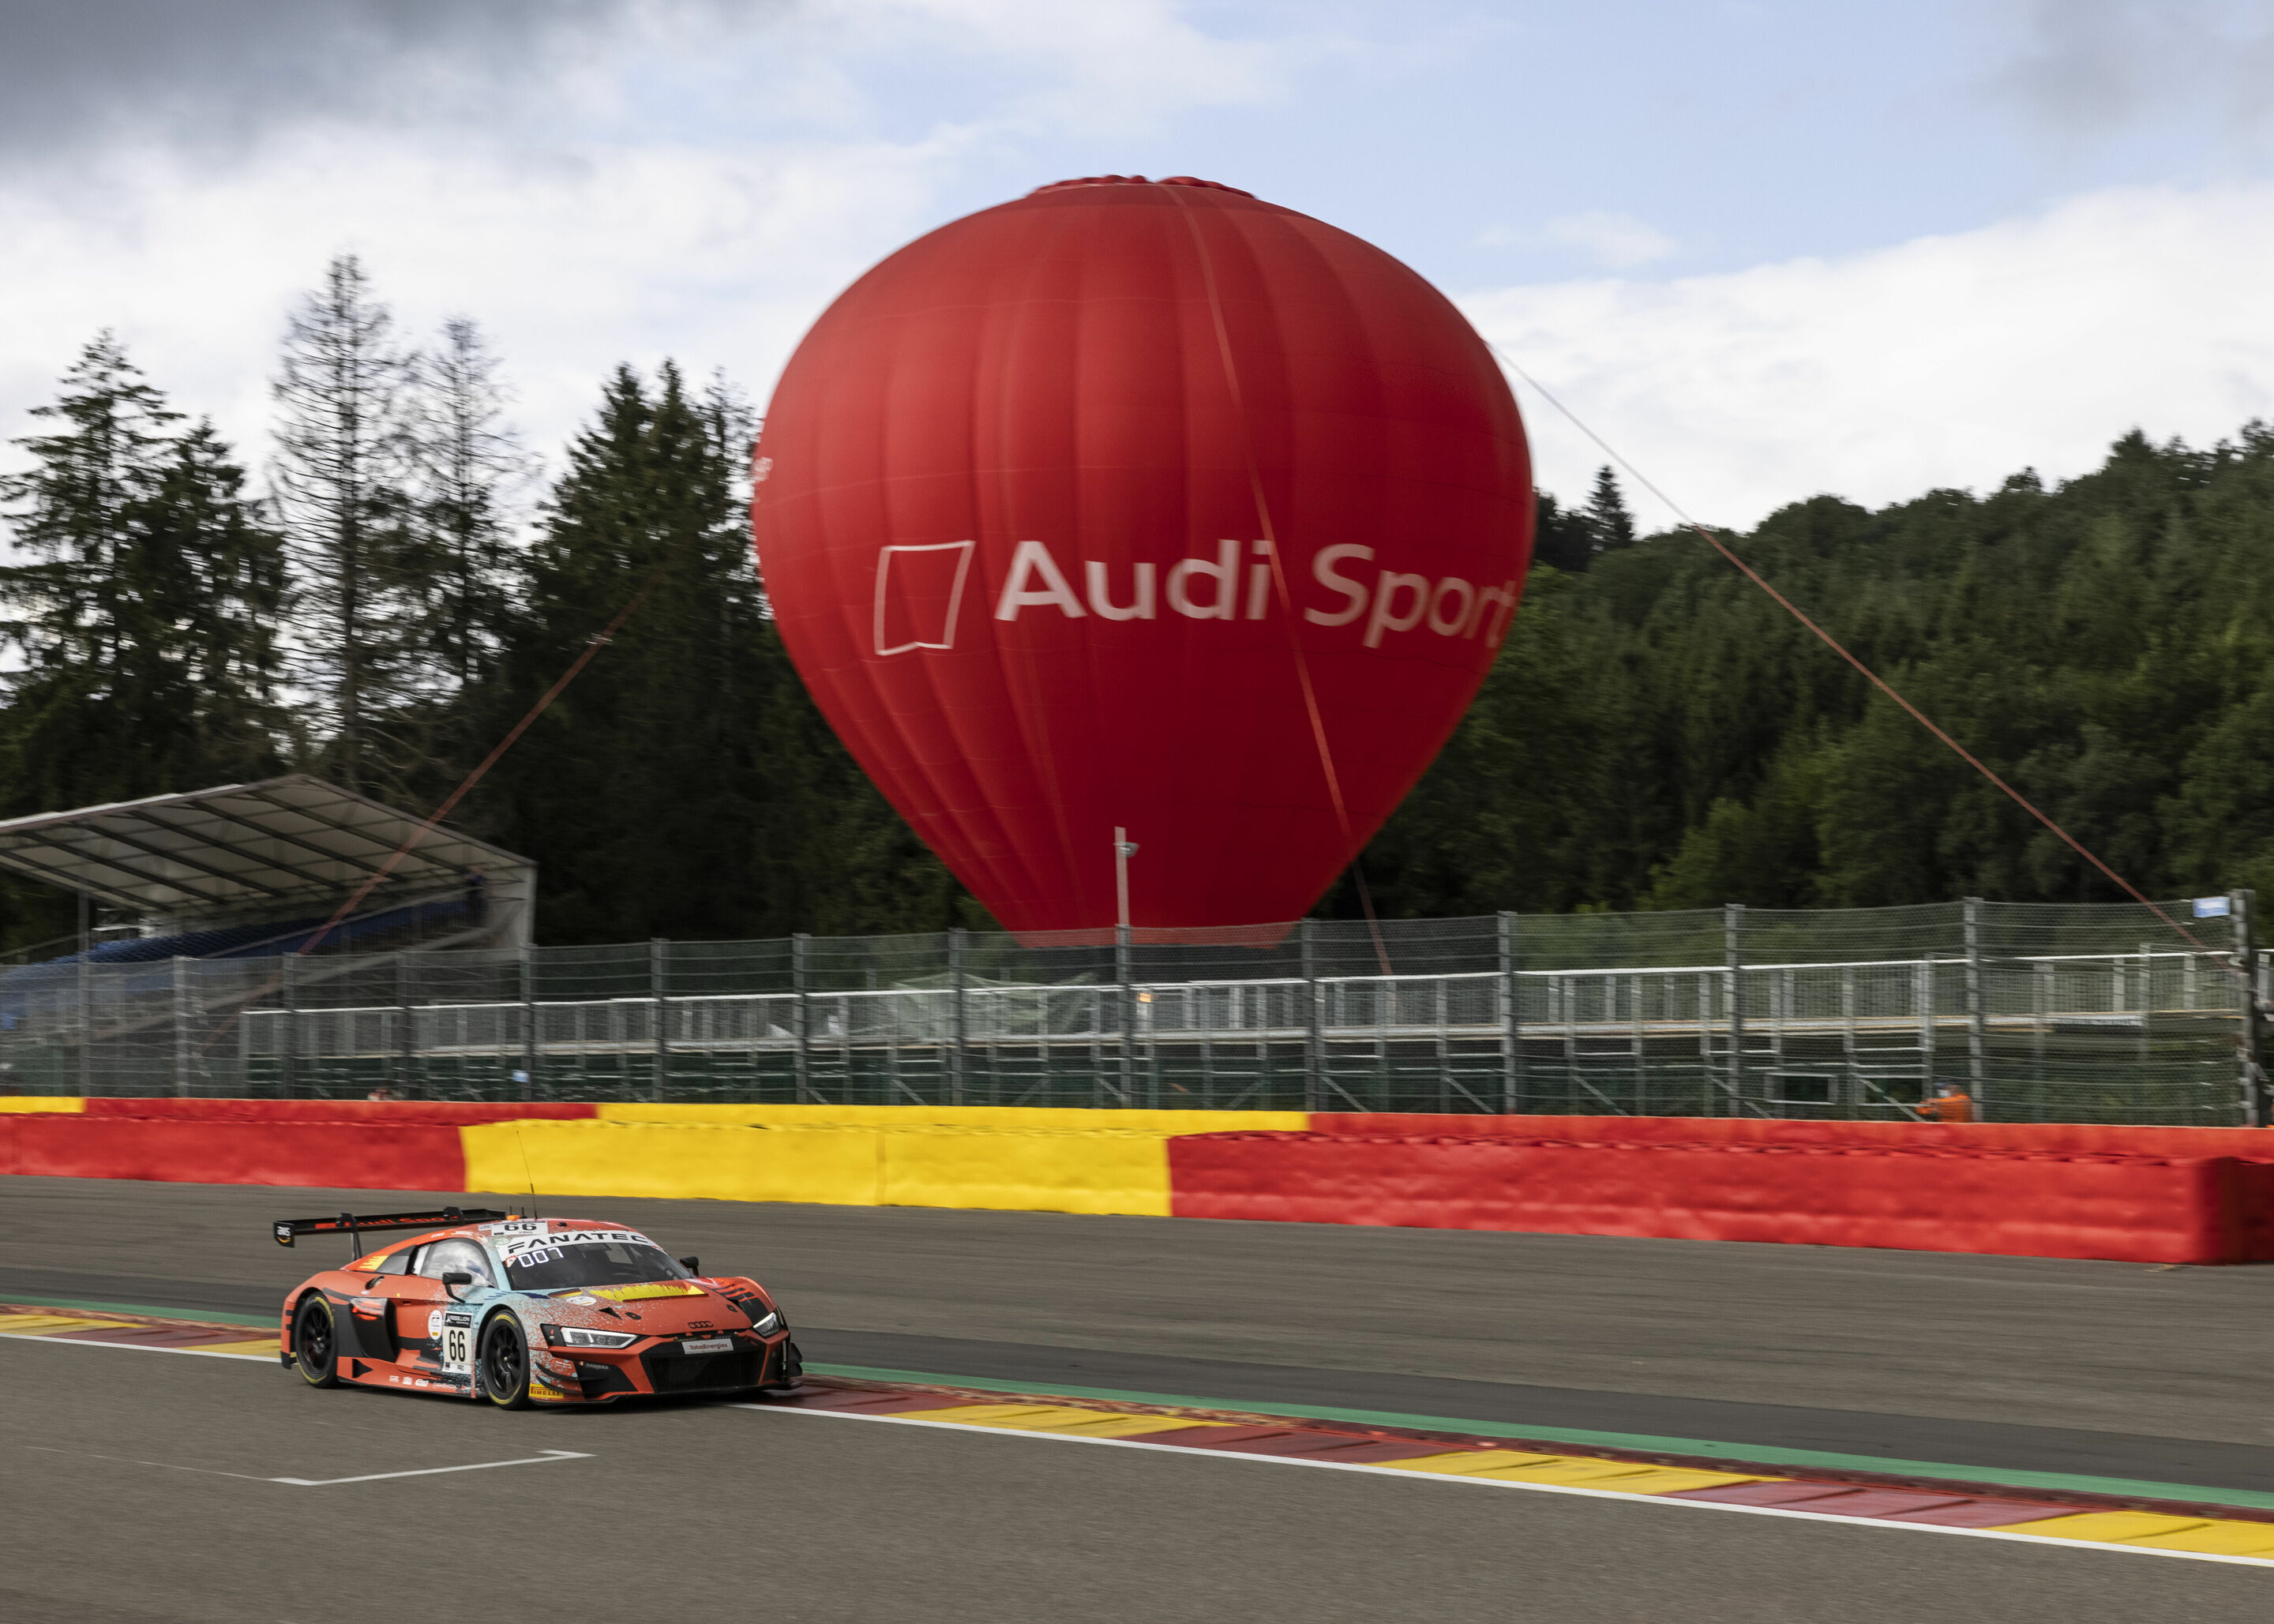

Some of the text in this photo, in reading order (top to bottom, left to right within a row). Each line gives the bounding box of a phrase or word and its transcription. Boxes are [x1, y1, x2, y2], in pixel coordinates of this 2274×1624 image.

[994, 539, 1517, 649] Audi Sport
[508, 1233, 648, 1254] FANATEC
[449, 1330, 466, 1362] 66
[531, 1386, 560, 1397] PIRELLI
